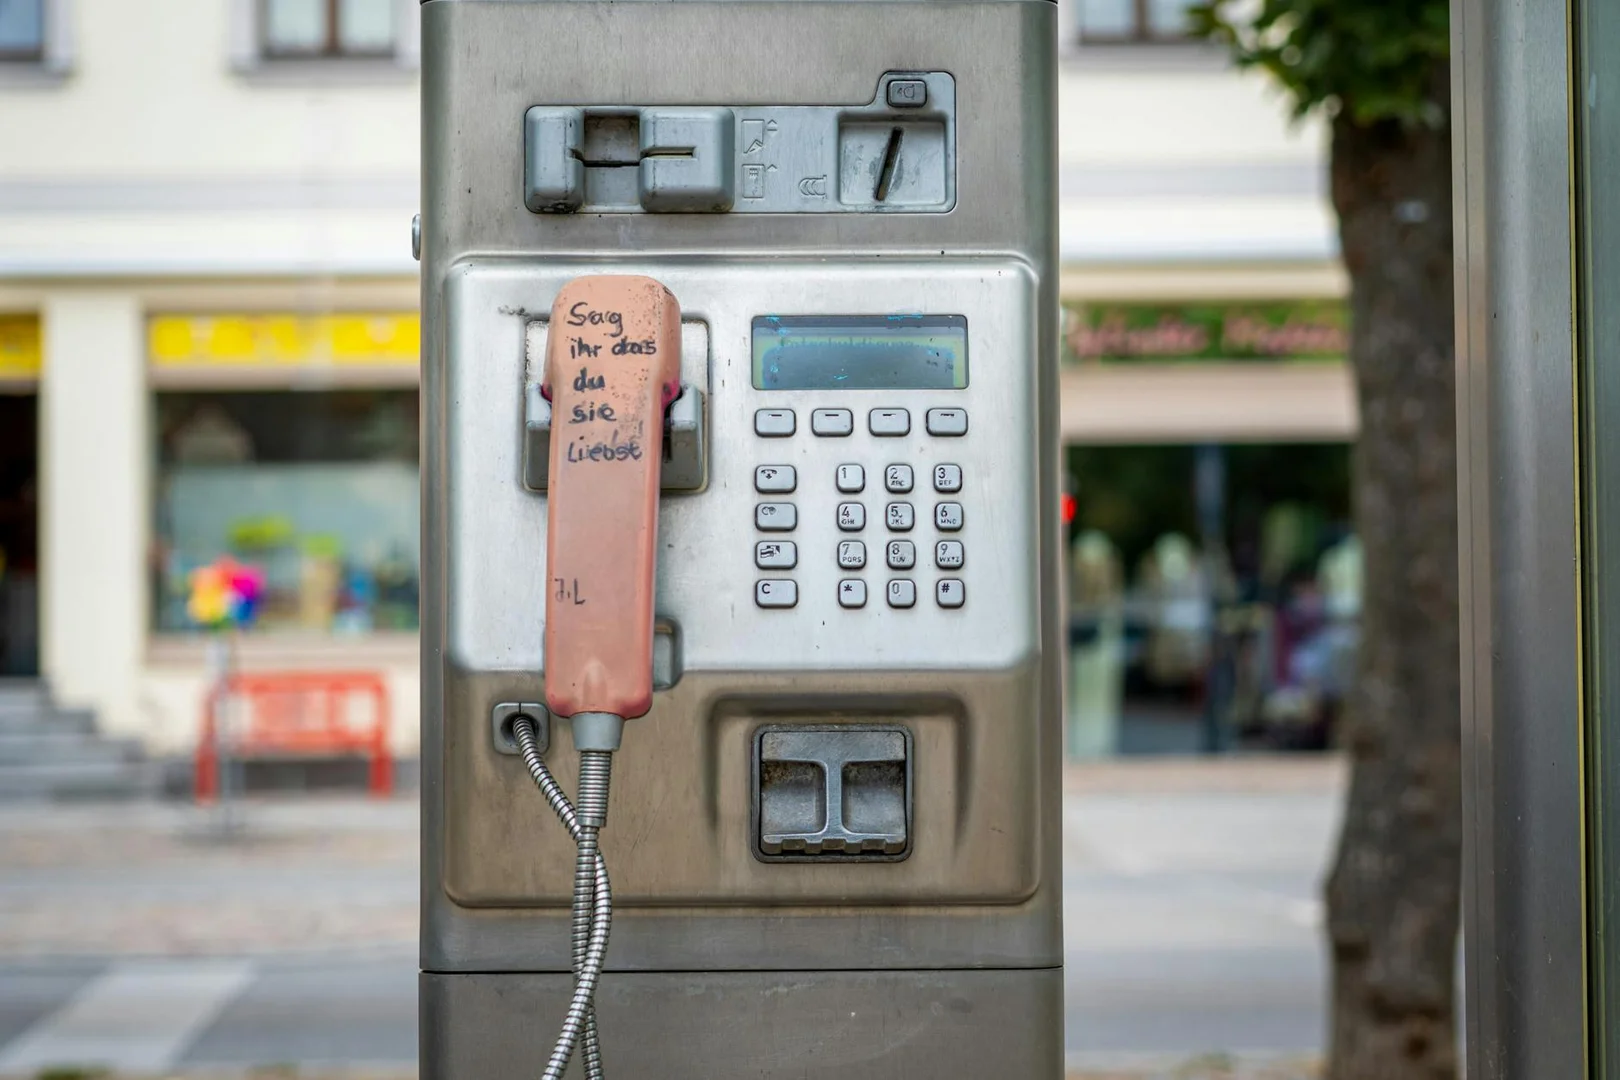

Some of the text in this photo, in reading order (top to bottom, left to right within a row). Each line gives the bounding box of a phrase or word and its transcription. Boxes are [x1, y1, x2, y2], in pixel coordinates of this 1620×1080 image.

[567, 301, 623, 338] Sag
[570, 335, 657, 359] ihr das
[573, 366, 606, 393] du
[568, 400, 617, 424] sie
[841, 467, 847, 479] 1
[890, 467, 898, 480] 2
[938, 467, 946, 479] 3
[841, 505, 850, 518] 4
[891, 505, 899, 517] 5
[940, 505, 948, 518] 6
[842, 543, 850, 556] 7
[892, 543, 900, 556] 8
[940, 543, 948, 556] 9
[761, 583, 771, 595] C
[892, 582, 900, 595] 0
[941, 582, 950, 593] #
